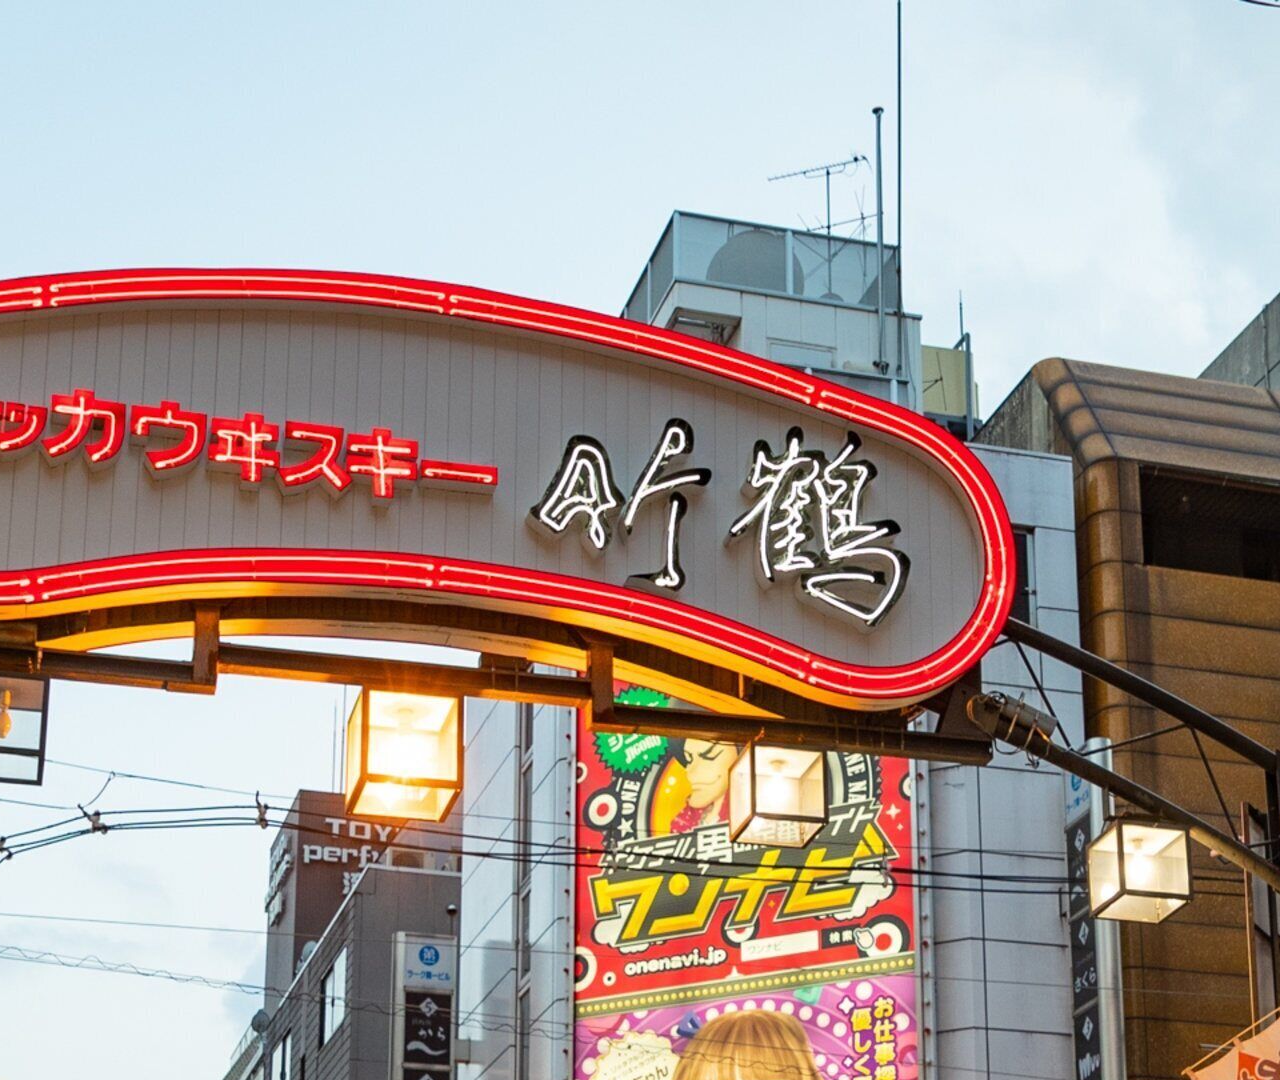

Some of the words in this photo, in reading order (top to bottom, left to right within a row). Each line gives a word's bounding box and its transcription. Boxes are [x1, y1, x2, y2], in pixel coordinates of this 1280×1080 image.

[528, 417, 910, 626] 竹鶴
[325, 817, 401, 842] TOY
[591, 828, 886, 942] ワンナビ
[624, 946, 727, 976] onenavi.jp
